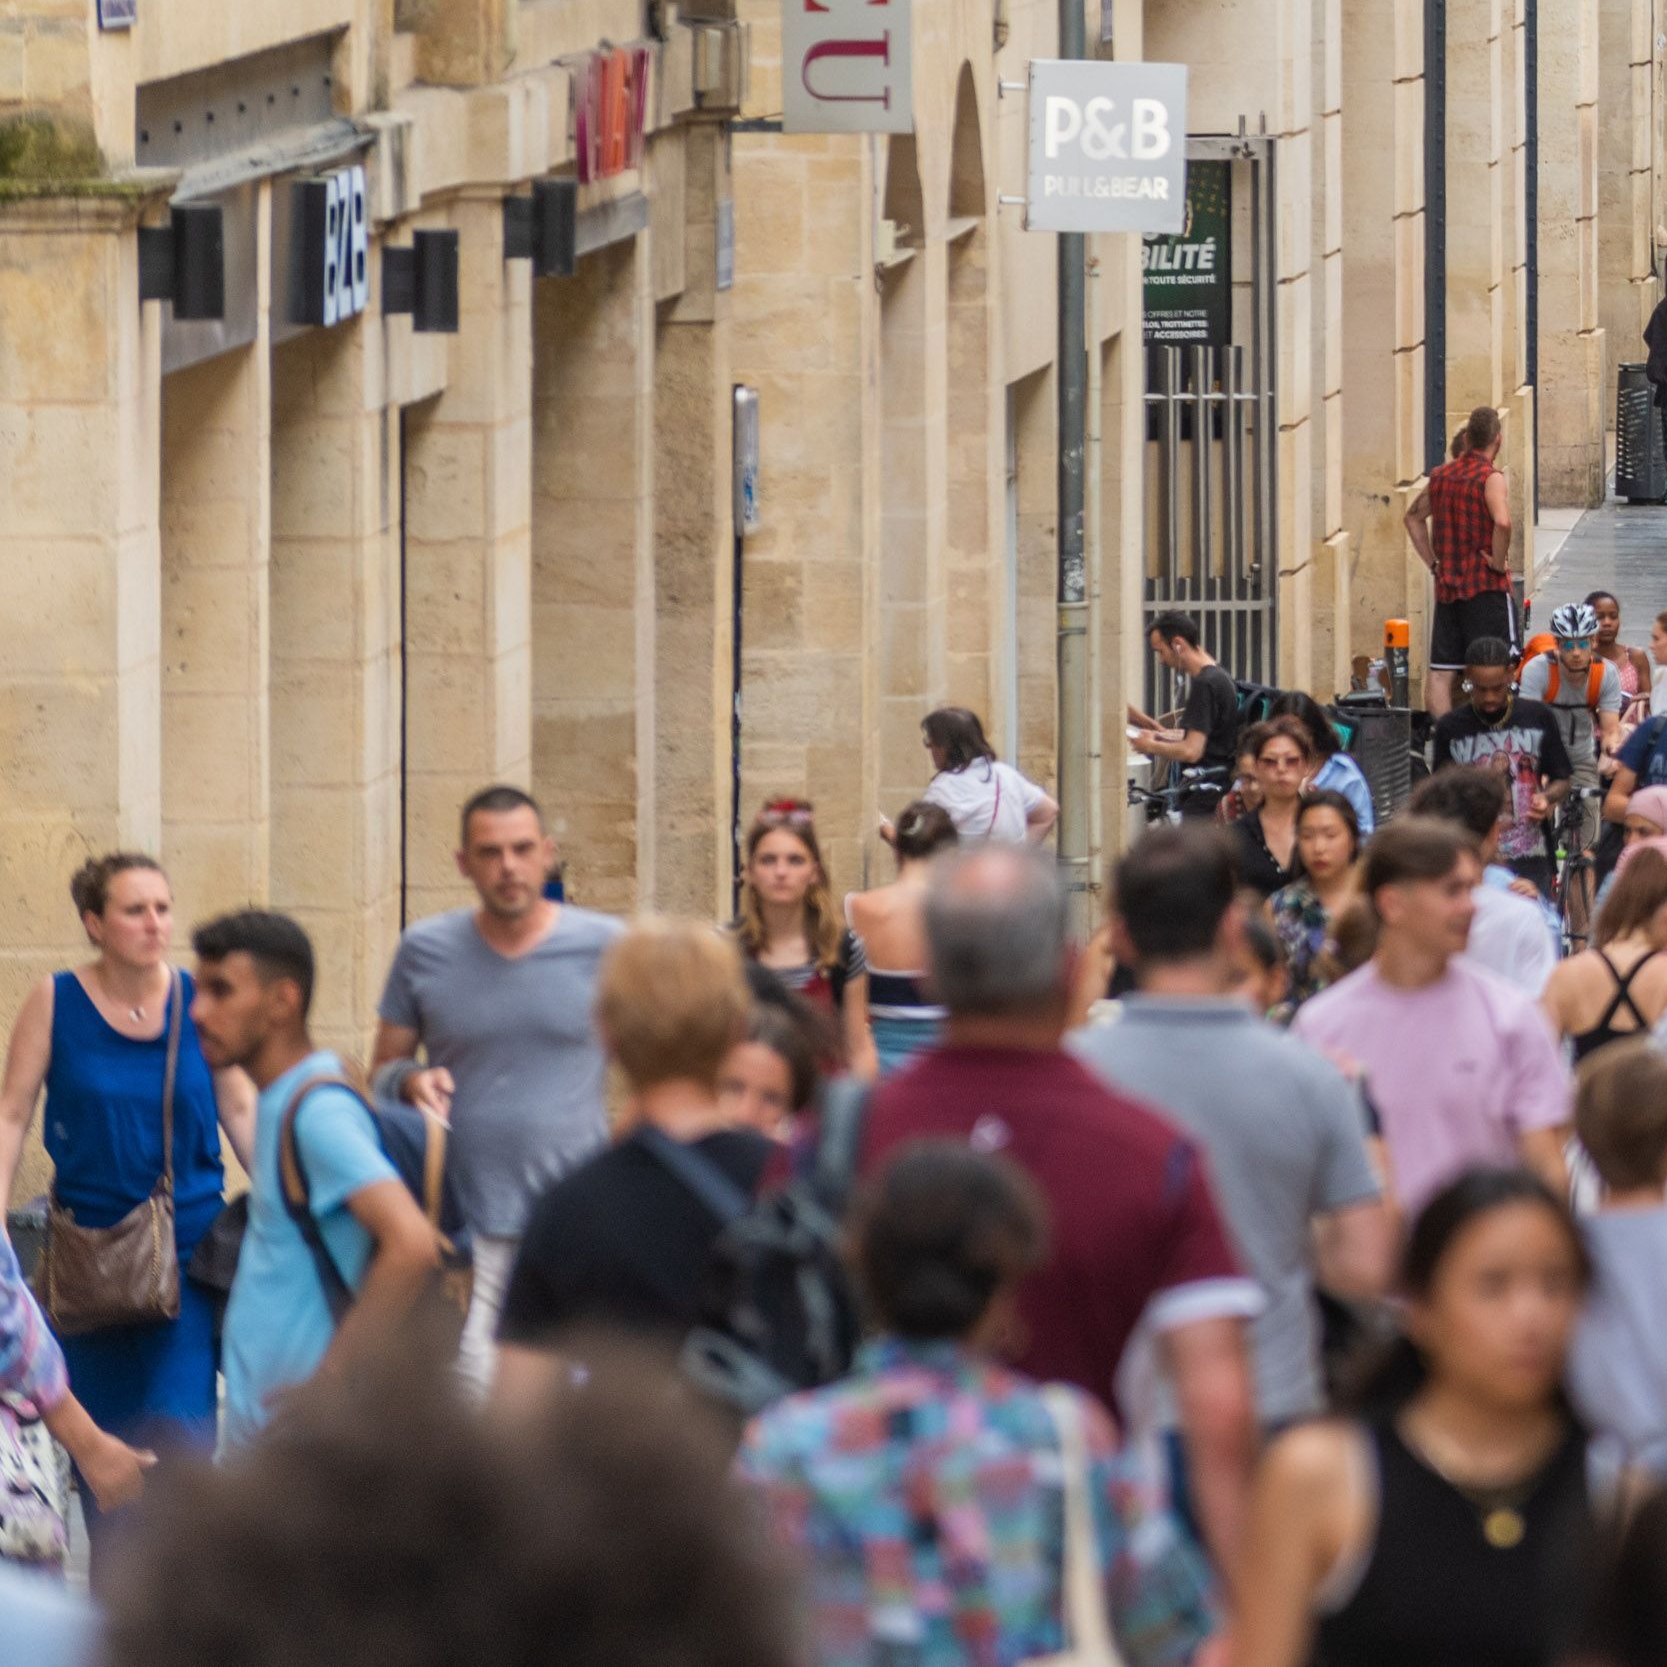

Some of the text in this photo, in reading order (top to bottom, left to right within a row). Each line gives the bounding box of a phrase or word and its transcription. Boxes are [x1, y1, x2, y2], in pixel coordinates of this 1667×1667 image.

[1045, 96, 1171, 161] P&B
[1044, 175, 1169, 201] PULL&BEAR
[1149, 273, 1216, 284] TOUTE SÉCURITÉ
